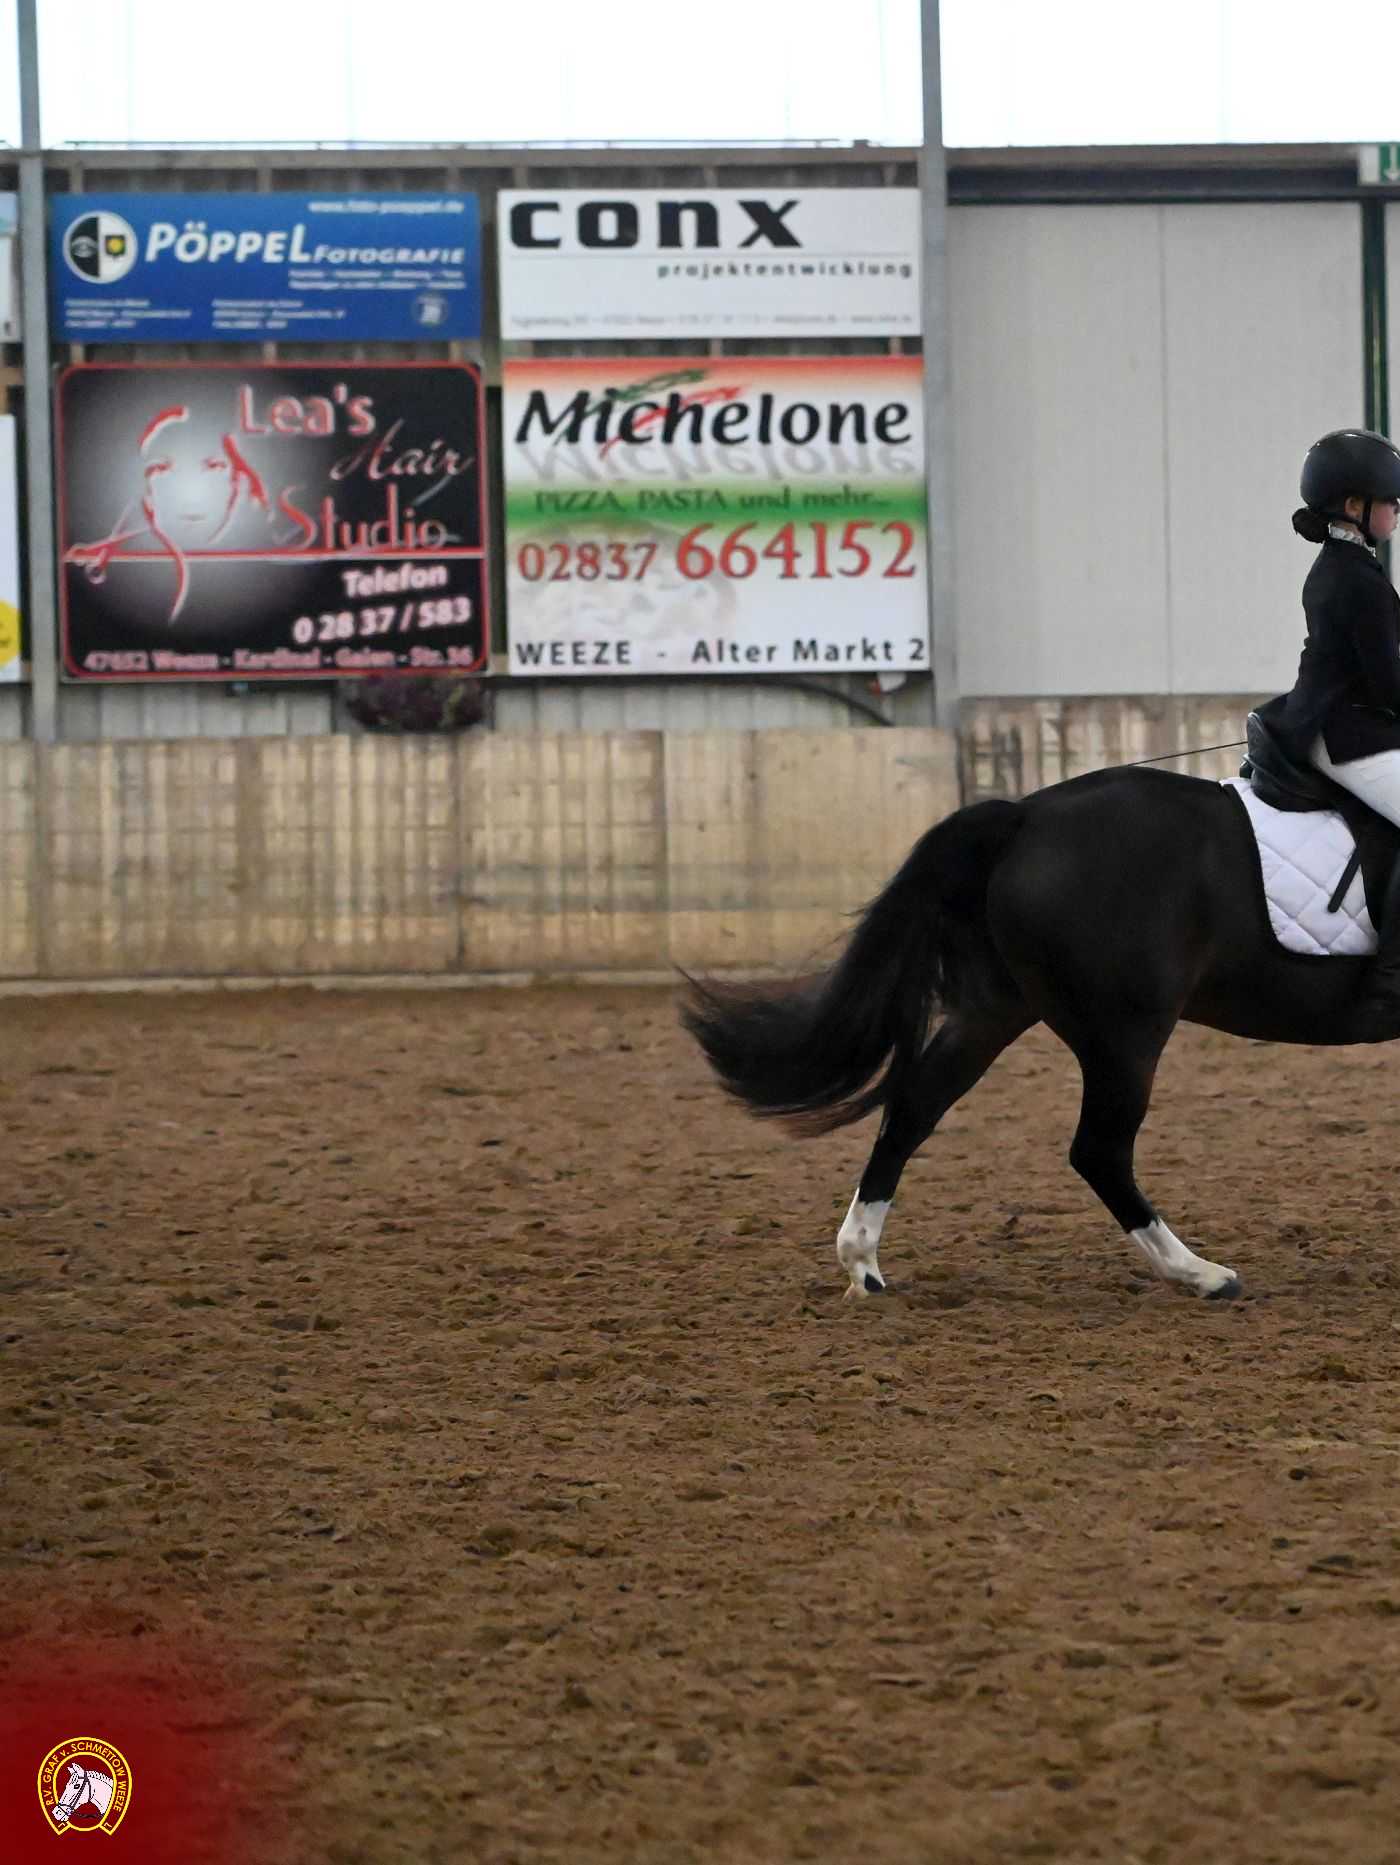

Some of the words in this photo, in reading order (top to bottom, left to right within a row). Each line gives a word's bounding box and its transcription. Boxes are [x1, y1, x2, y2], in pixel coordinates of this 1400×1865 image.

[145, 220, 312, 263] PÖPPEL
[313, 244, 465, 264] FOTOGRAFIE
[509, 199, 803, 249] conx
[657, 262, 912, 279] projektentwicklung
[239, 383, 377, 434] Lea's
[515, 388, 912, 447] Michelone
[273, 483, 461, 550] Studio
[637, 489, 726, 511] PASTA
[738, 487, 790, 509] und
[517, 542, 658, 582] 02837
[676, 521, 917, 580] 664152
[343, 562, 448, 598] Telefon
[293, 616, 314, 644] 0
[318, 611, 355, 641] 28
[359, 605, 396, 637] 37
[418, 596, 472, 629] 583
[516, 641, 631, 665] WEEZE
[692, 640, 778, 663] Alter
[792, 638, 894, 663] Markt
[909, 637, 925, 662] 2
